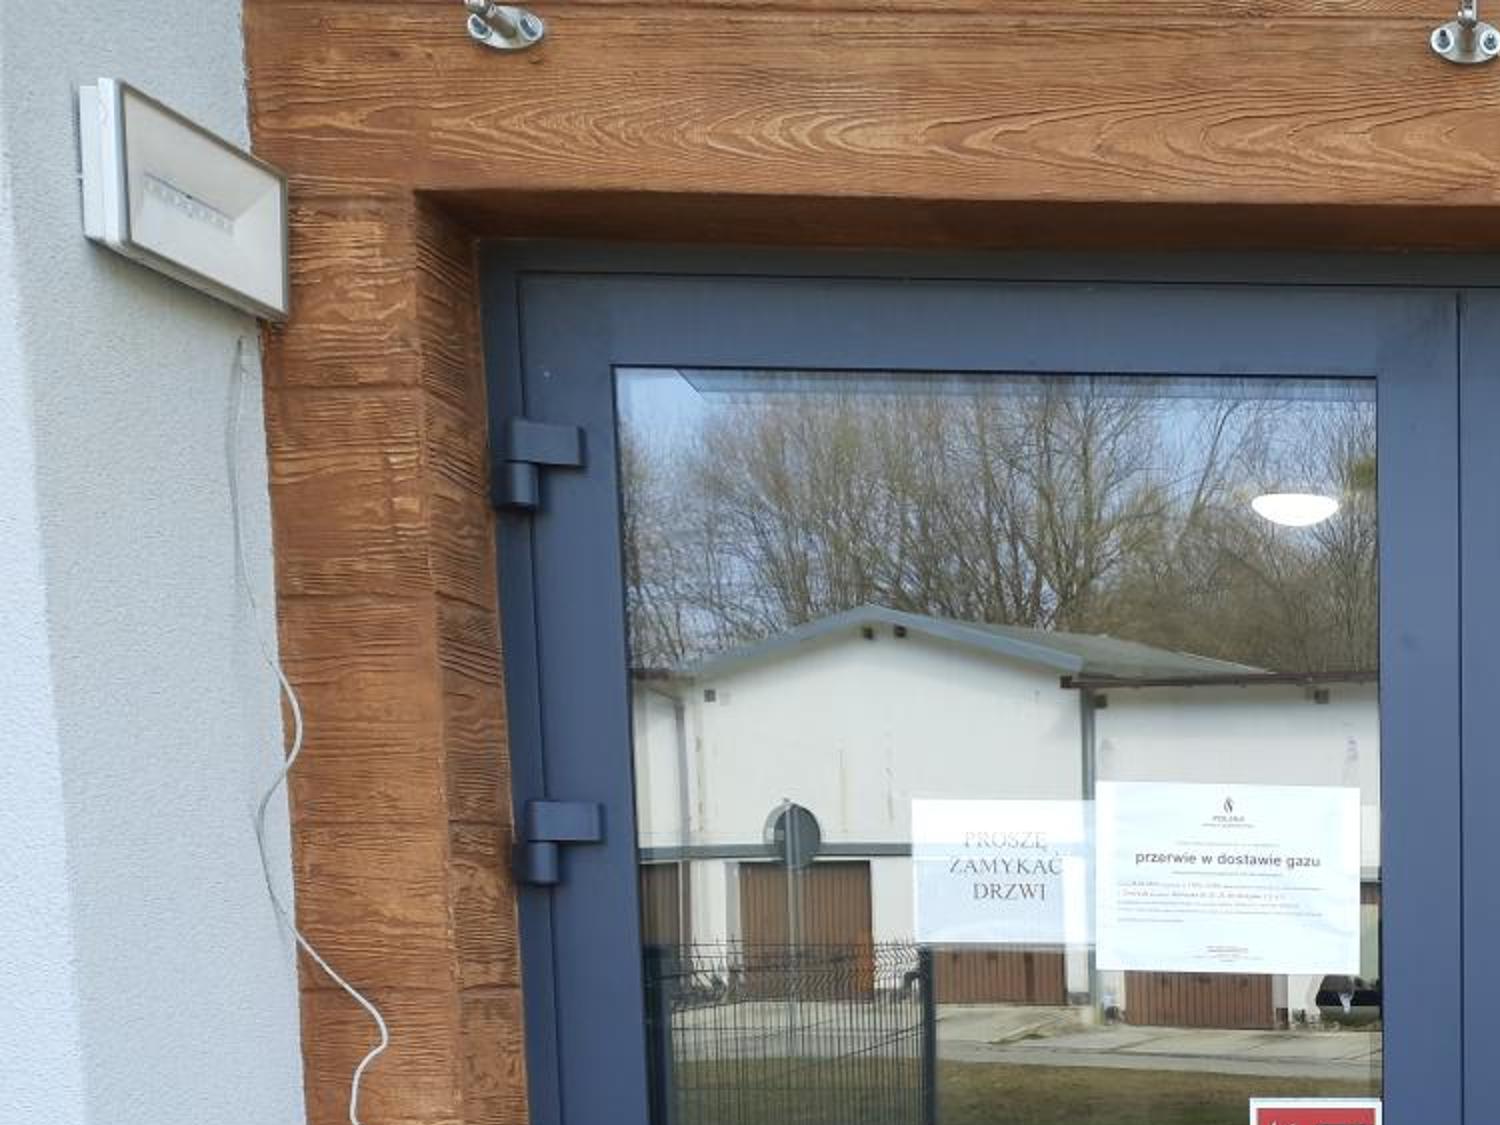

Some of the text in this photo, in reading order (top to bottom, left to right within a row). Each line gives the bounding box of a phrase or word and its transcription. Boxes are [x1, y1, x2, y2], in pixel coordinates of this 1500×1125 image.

[949, 851, 1064, 875] ZAMYKAĆ
[1135, 851, 1321, 869] przerwie w dostawie gazu
[973, 882, 1046, 901] DRZWI
